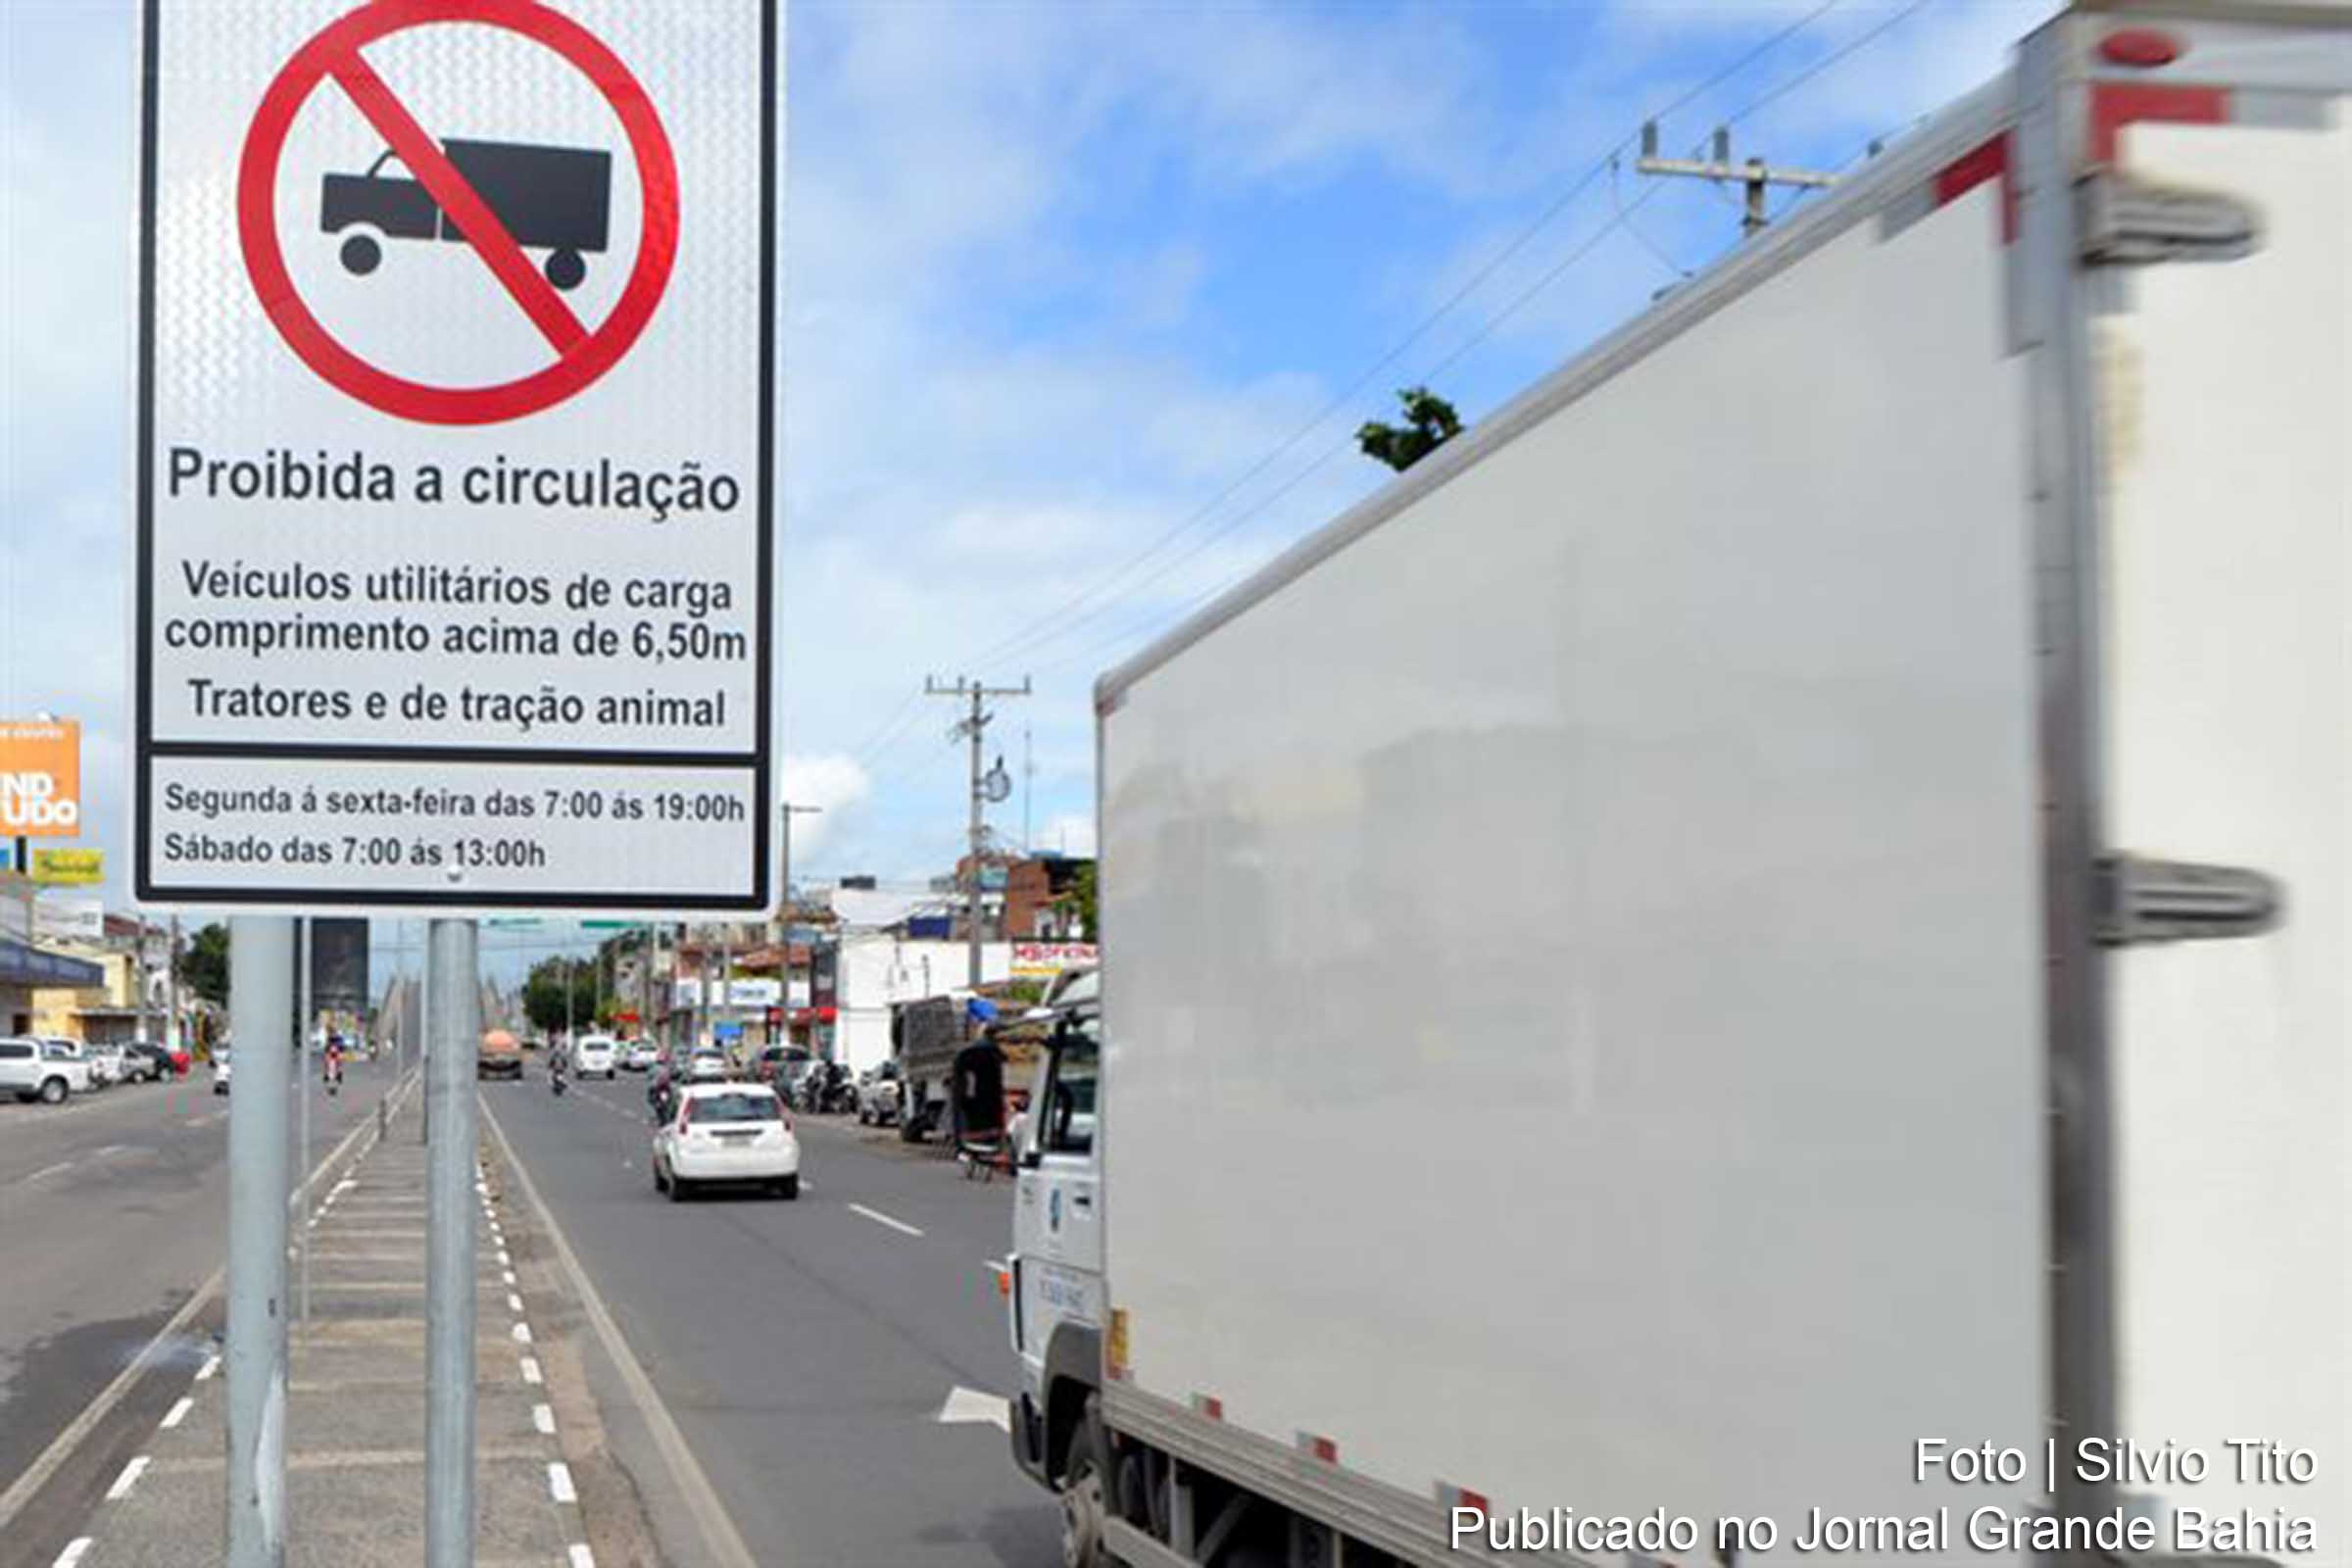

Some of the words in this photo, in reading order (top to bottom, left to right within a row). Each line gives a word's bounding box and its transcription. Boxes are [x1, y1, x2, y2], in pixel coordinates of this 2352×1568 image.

[169, 447, 395, 501] Proibida
[415, 466, 442, 503] a
[463, 455, 740, 522] circulação
[181, 560, 351, 601] Veículos
[367, 564, 551, 605] utilitários
[565, 574, 611, 610] de
[624, 579, 732, 618] carga
[165, 613, 429, 657] comprimento
[443, 616, 559, 655] acima
[572, 620, 619, 658] de
[632, 620, 746, 662] 6,50m
[187, 678, 352, 719] Tratores
[366, 691, 387, 719] e
[401, 683, 448, 721] de
[461, 686, 584, 731] tração
[597, 689, 724, 726] animal
[165, 783, 292, 818] Segunda
[301, 788, 316, 812] á
[326, 788, 475, 816] sexta-feira
[484, 790, 535, 817] das
[545, 791, 603, 819] 7:00
[612, 792, 644, 820] ás
[655, 793, 745, 821] 19:00h
[165, 833, 273, 862] Sábado
[281, 837, 332, 863] das
[343, 837, 401, 865] 7:00
[410, 838, 443, 865] ás
[454, 839, 545, 867] 13:00h
